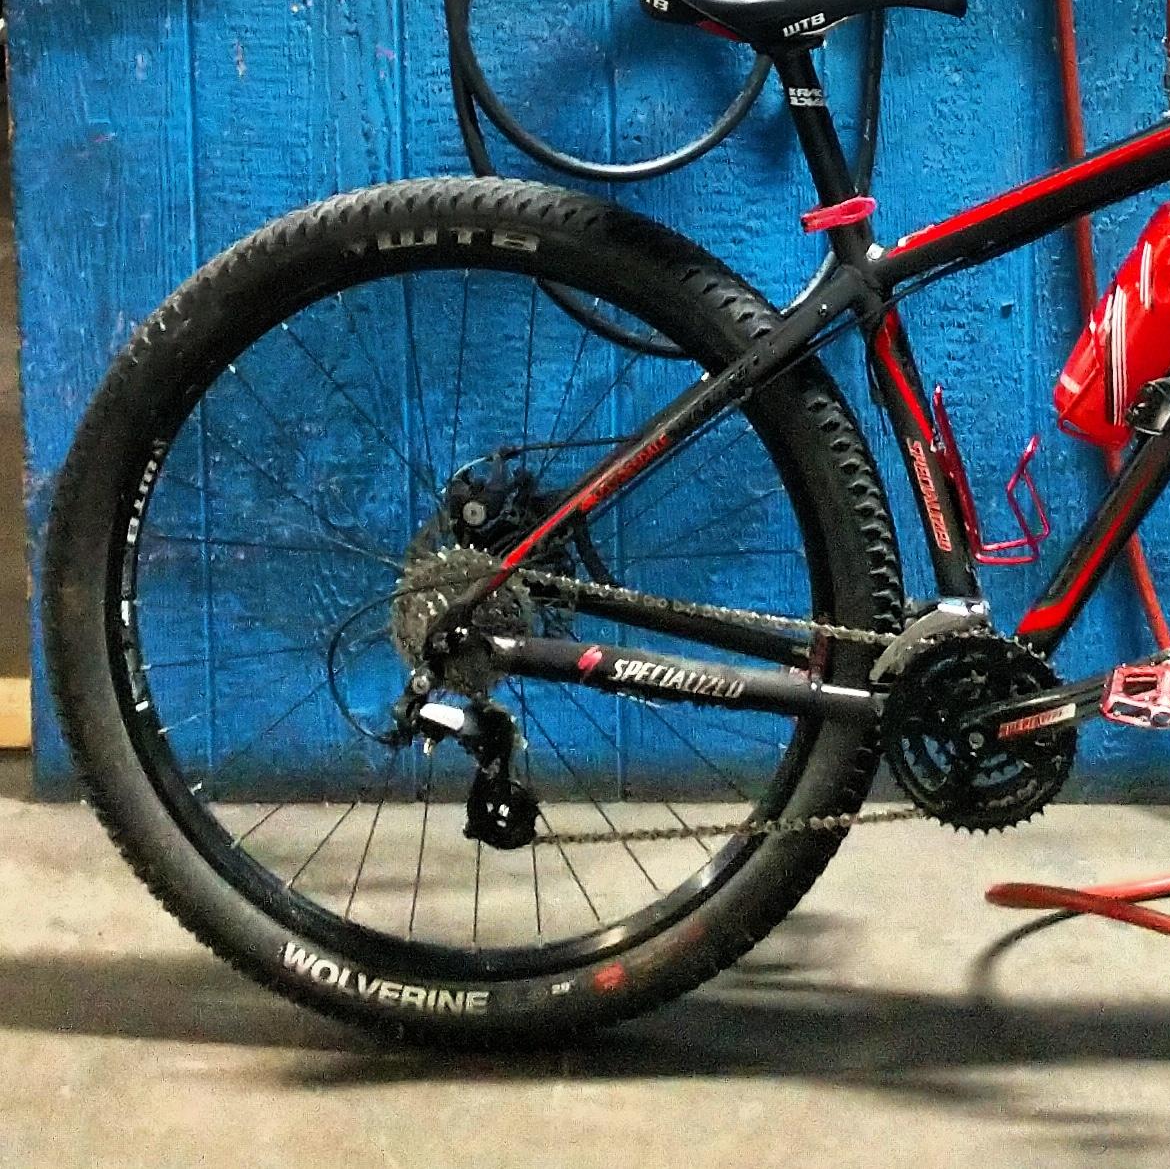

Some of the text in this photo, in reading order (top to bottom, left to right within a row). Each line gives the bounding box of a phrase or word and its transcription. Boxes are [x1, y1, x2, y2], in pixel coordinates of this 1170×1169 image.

[783, 12, 826, 38] WTB
[377, 226, 540, 252] WTB
[609, 658, 746, 699] SPECIALIZED
[281, 941, 490, 1015] WOLVERINE
